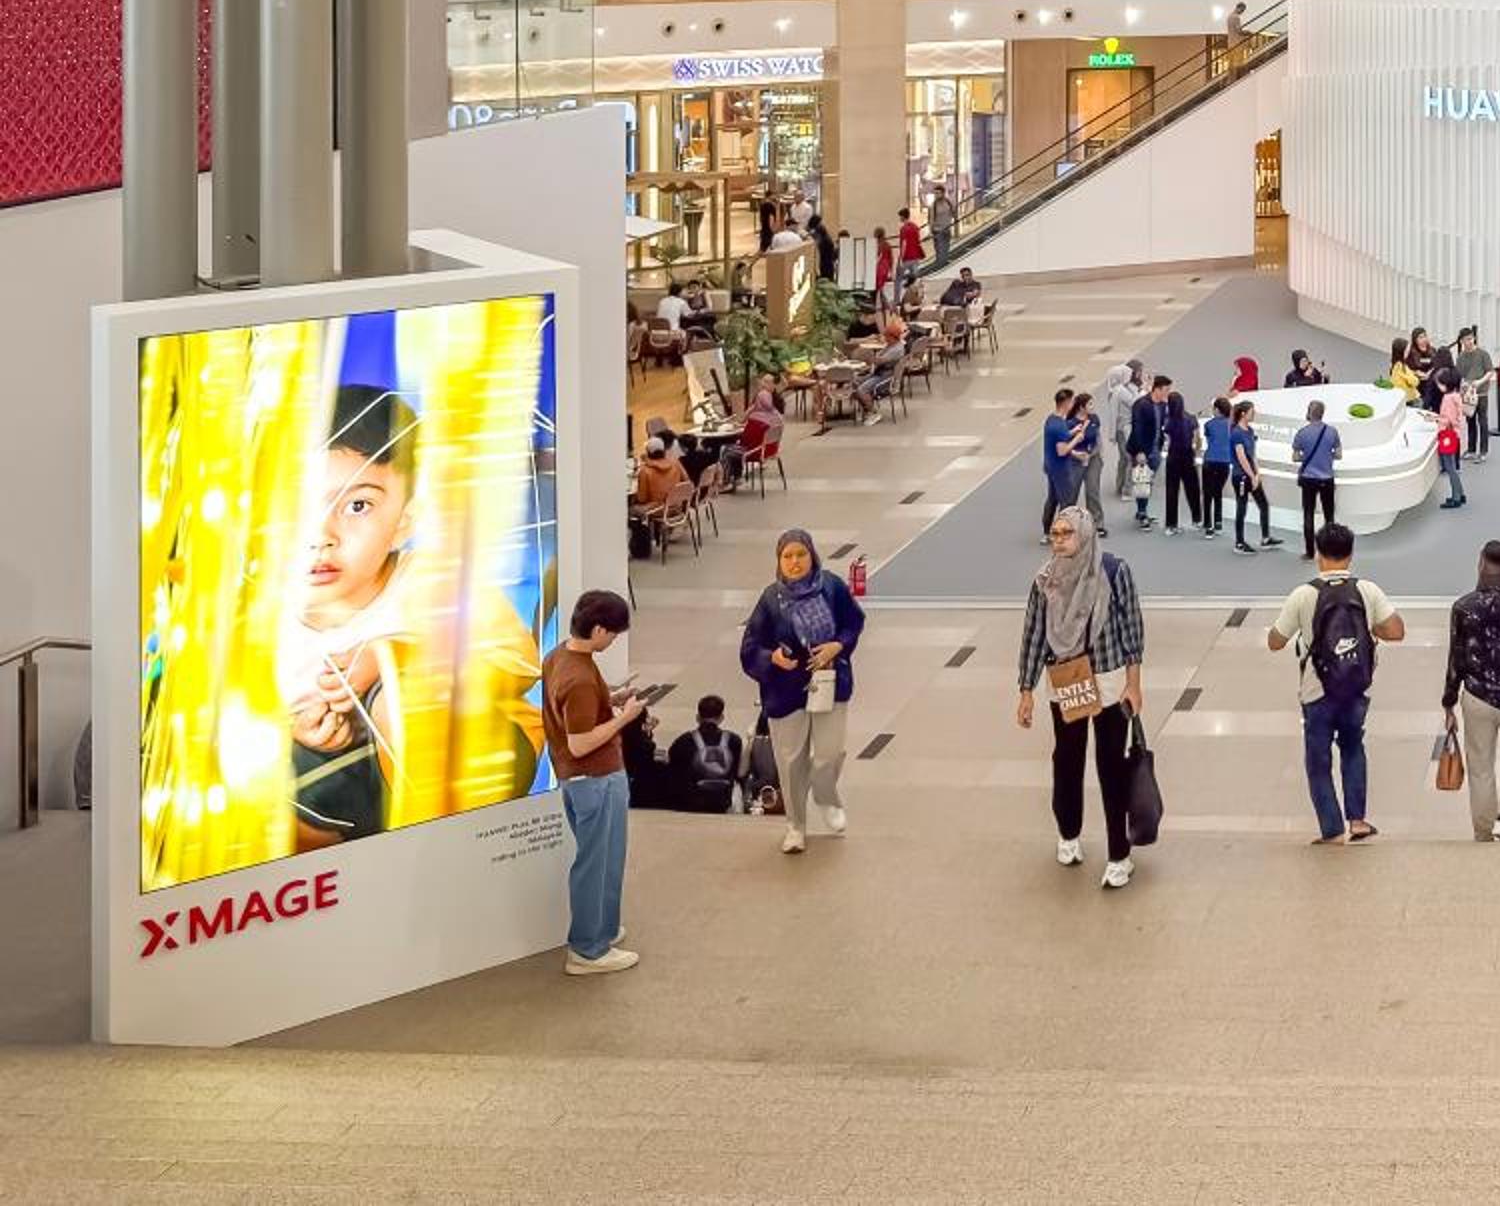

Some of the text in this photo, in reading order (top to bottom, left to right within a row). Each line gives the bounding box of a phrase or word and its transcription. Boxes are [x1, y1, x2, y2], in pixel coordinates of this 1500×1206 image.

[699, 57, 763, 78] SWISS
[1089, 53, 1135, 66] ROLEX
[140, 869, 339, 958] XMAGE
